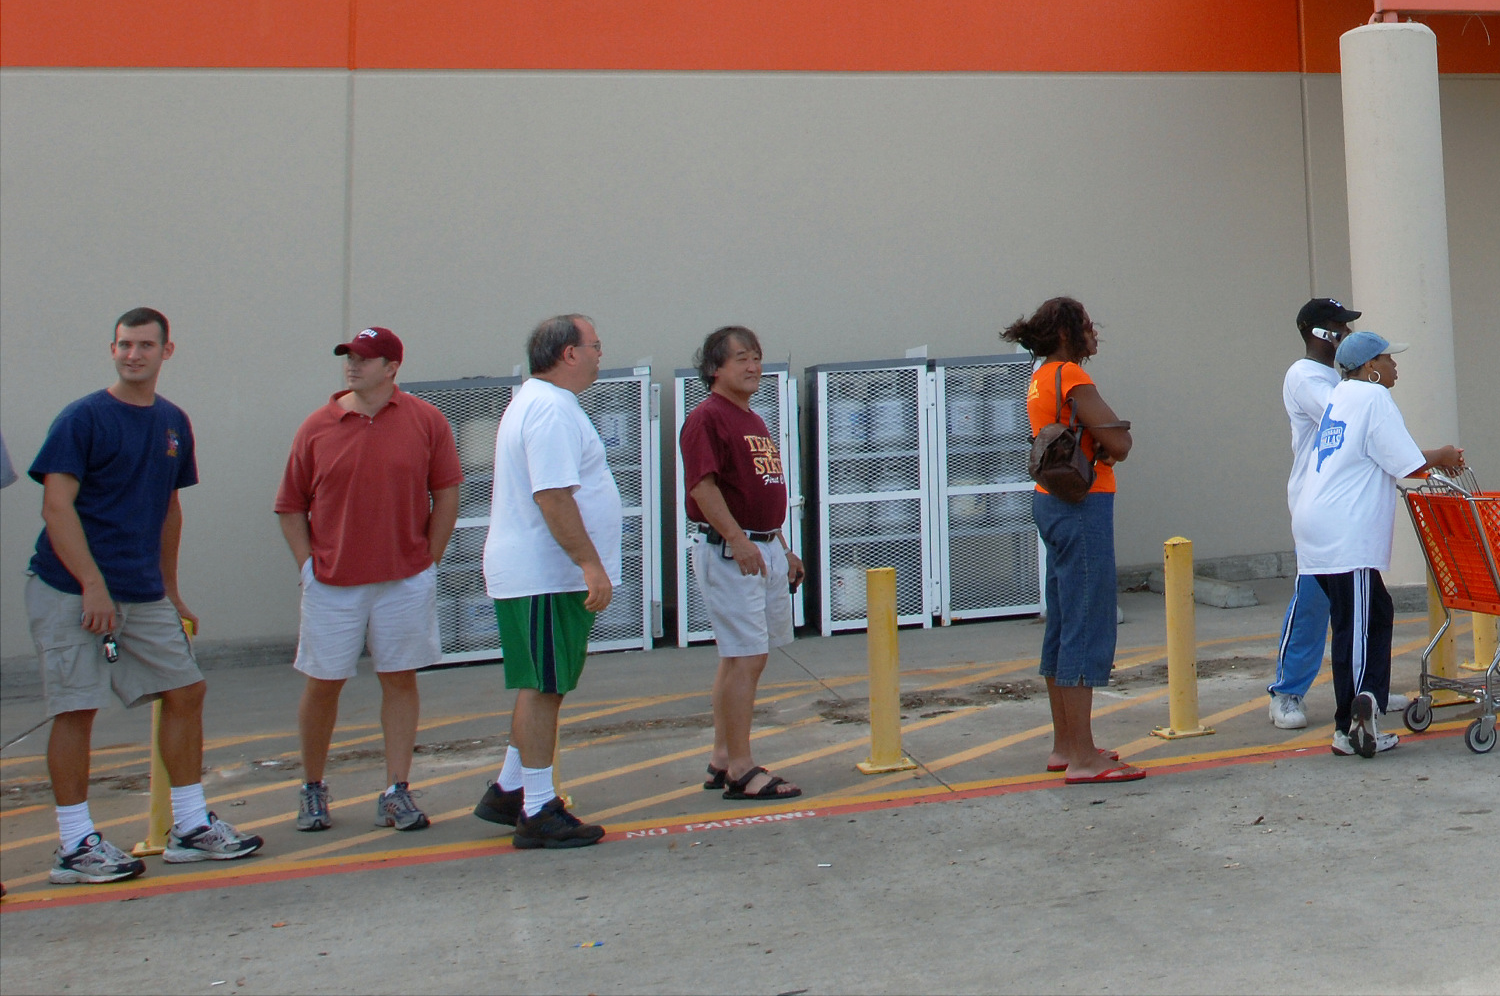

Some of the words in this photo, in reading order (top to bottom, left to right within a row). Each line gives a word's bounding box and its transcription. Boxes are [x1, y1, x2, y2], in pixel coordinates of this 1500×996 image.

[743, 435, 778, 453] TEXA
[753, 457, 782, 475] STAT
[626, 827, 668, 839] NO
